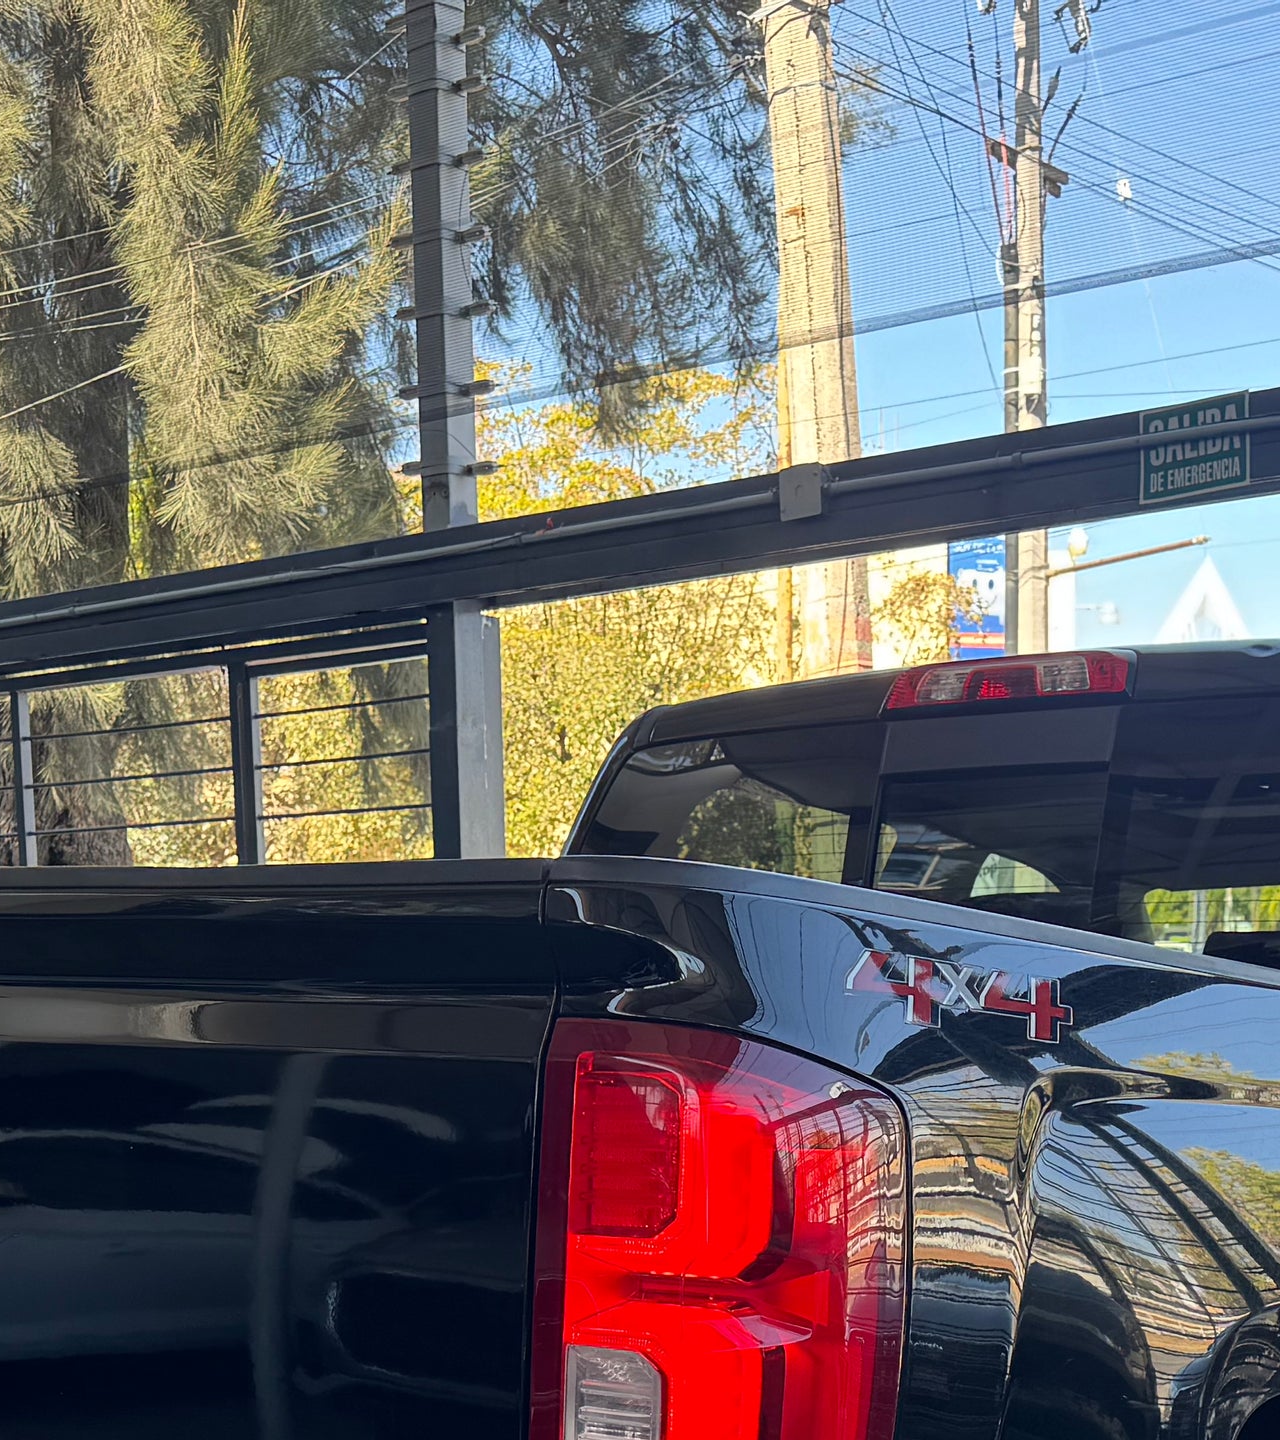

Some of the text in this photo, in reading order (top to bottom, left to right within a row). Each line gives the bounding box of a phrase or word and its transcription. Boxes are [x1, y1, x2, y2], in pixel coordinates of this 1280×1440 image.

[1149, 404, 1242, 467] SALIDA
[1150, 456, 1241, 493] DE EMERGENCIA
